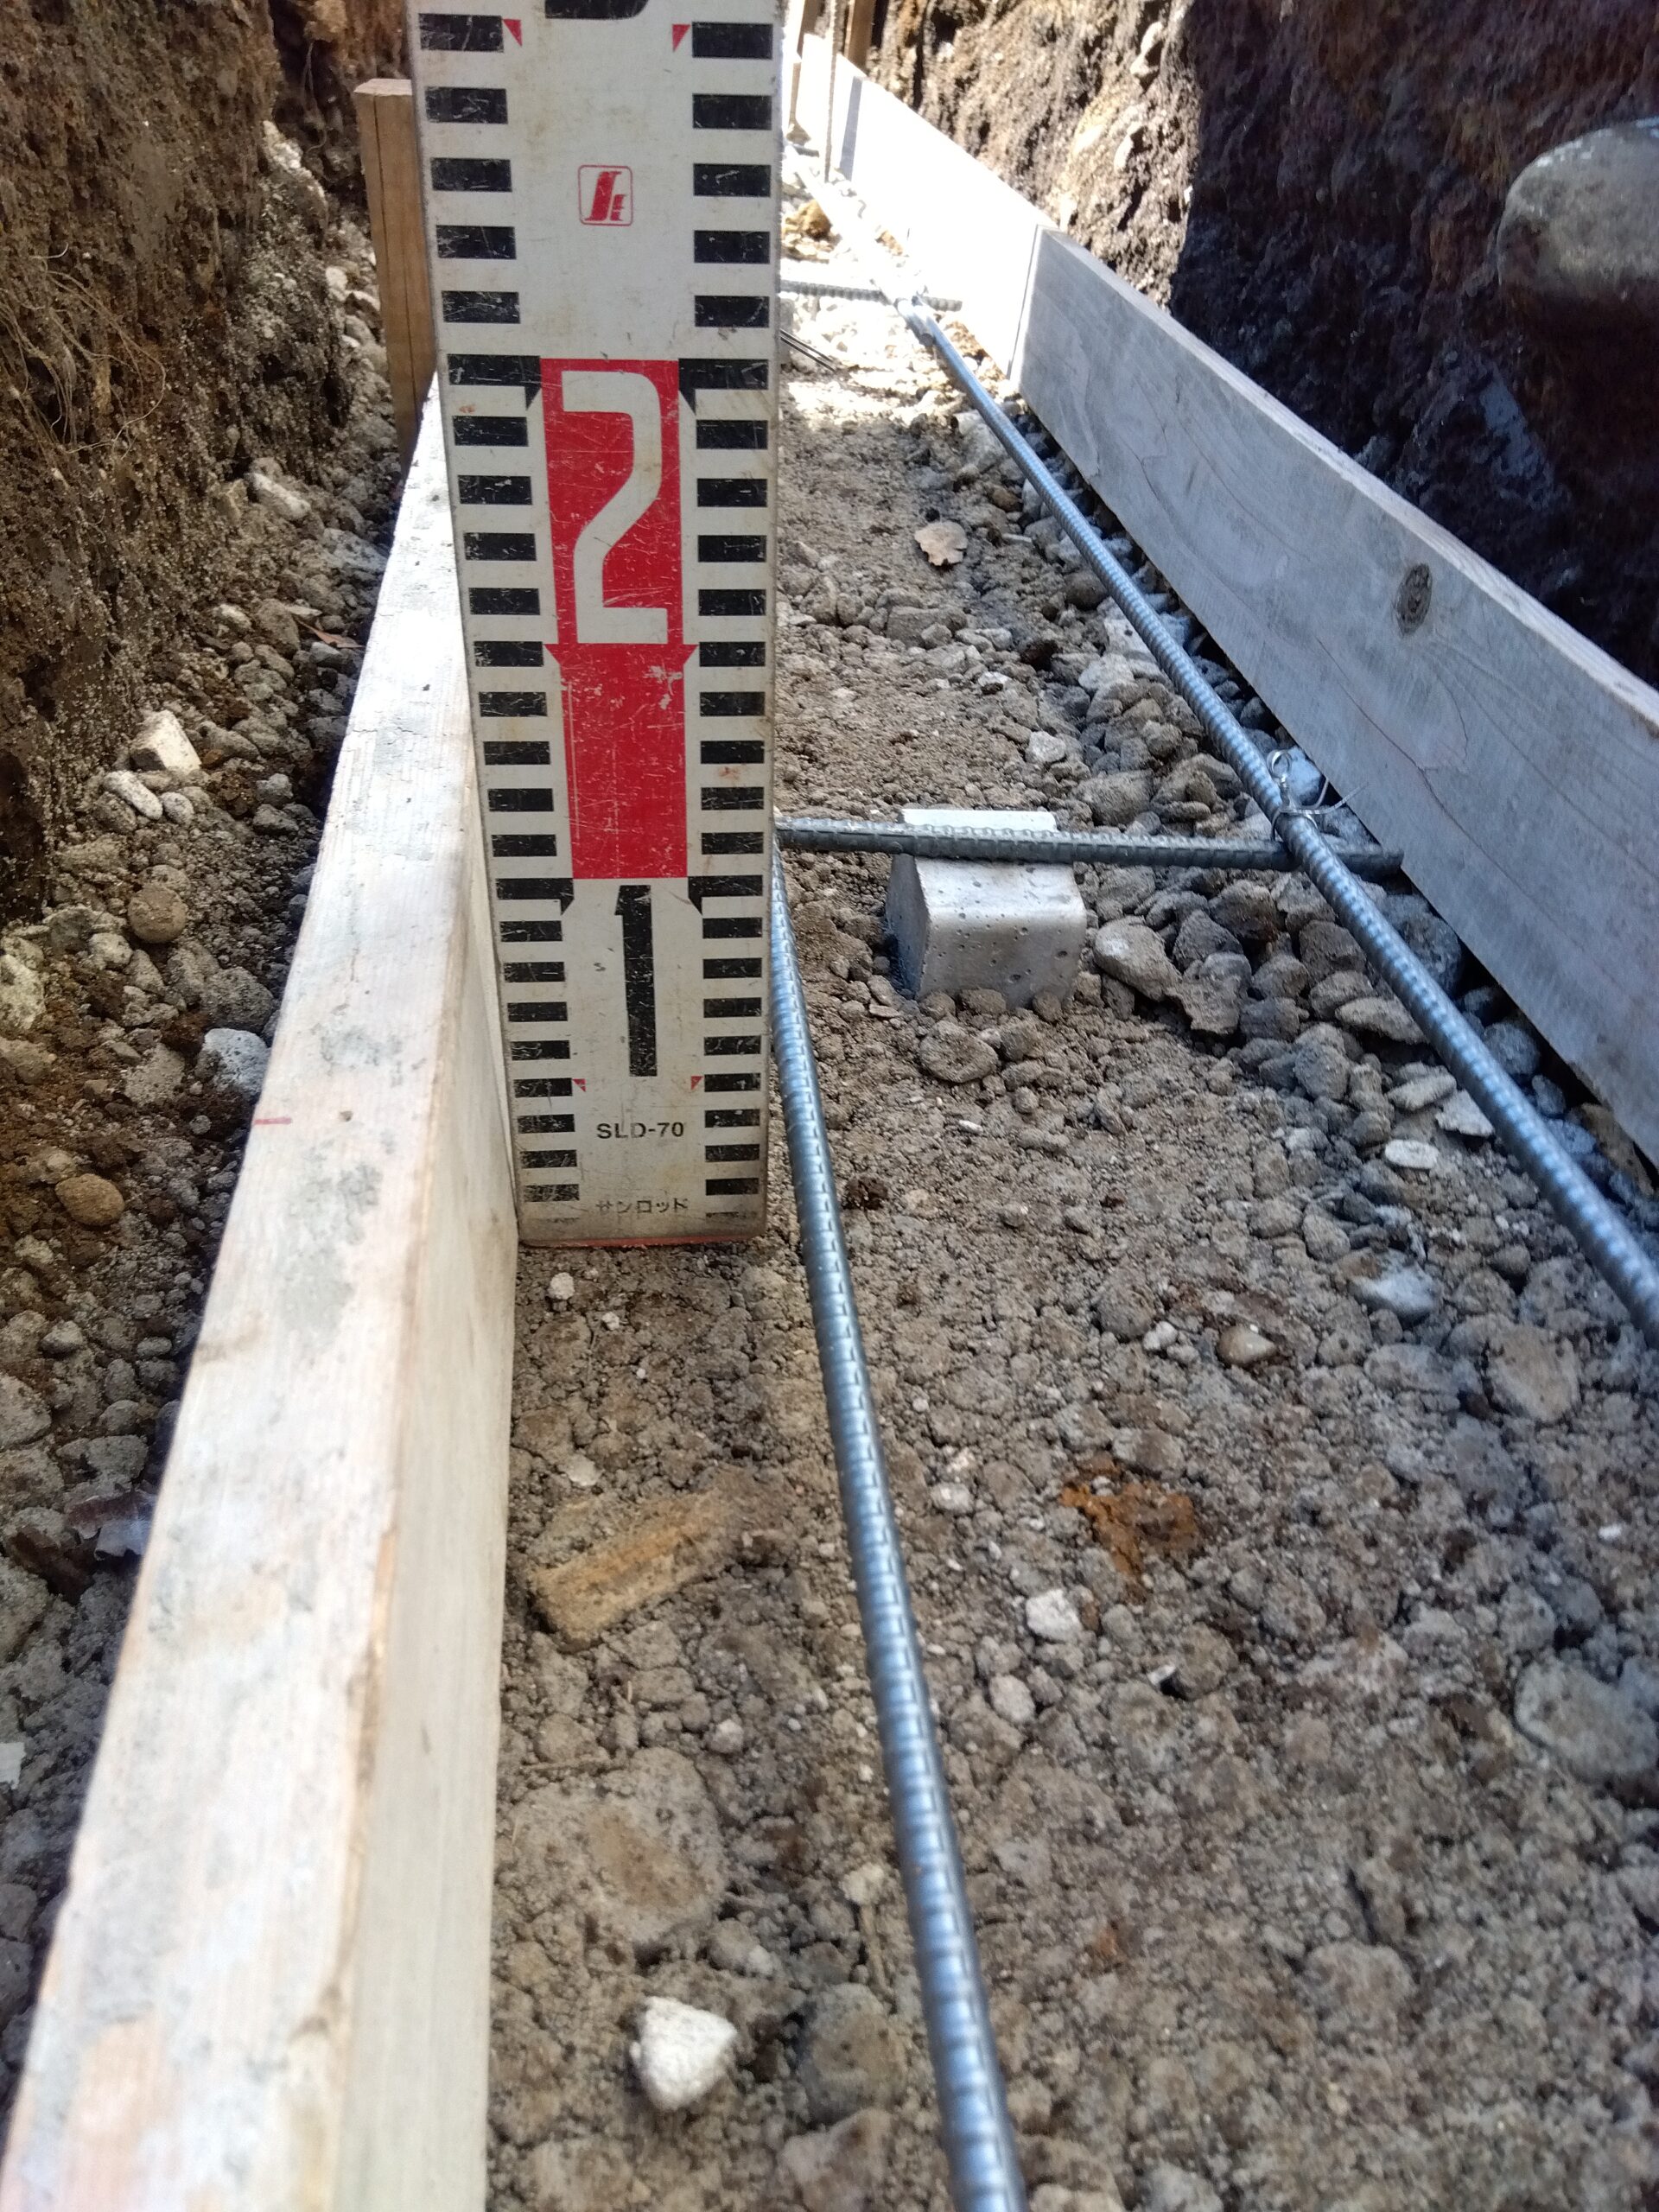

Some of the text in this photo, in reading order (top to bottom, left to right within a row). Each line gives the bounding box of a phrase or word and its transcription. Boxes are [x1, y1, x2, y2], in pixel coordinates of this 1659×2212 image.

[562, 371, 668, 644] 2
[614, 885, 658, 1077] 1
[596, 1122, 684, 1139] SLD-70
